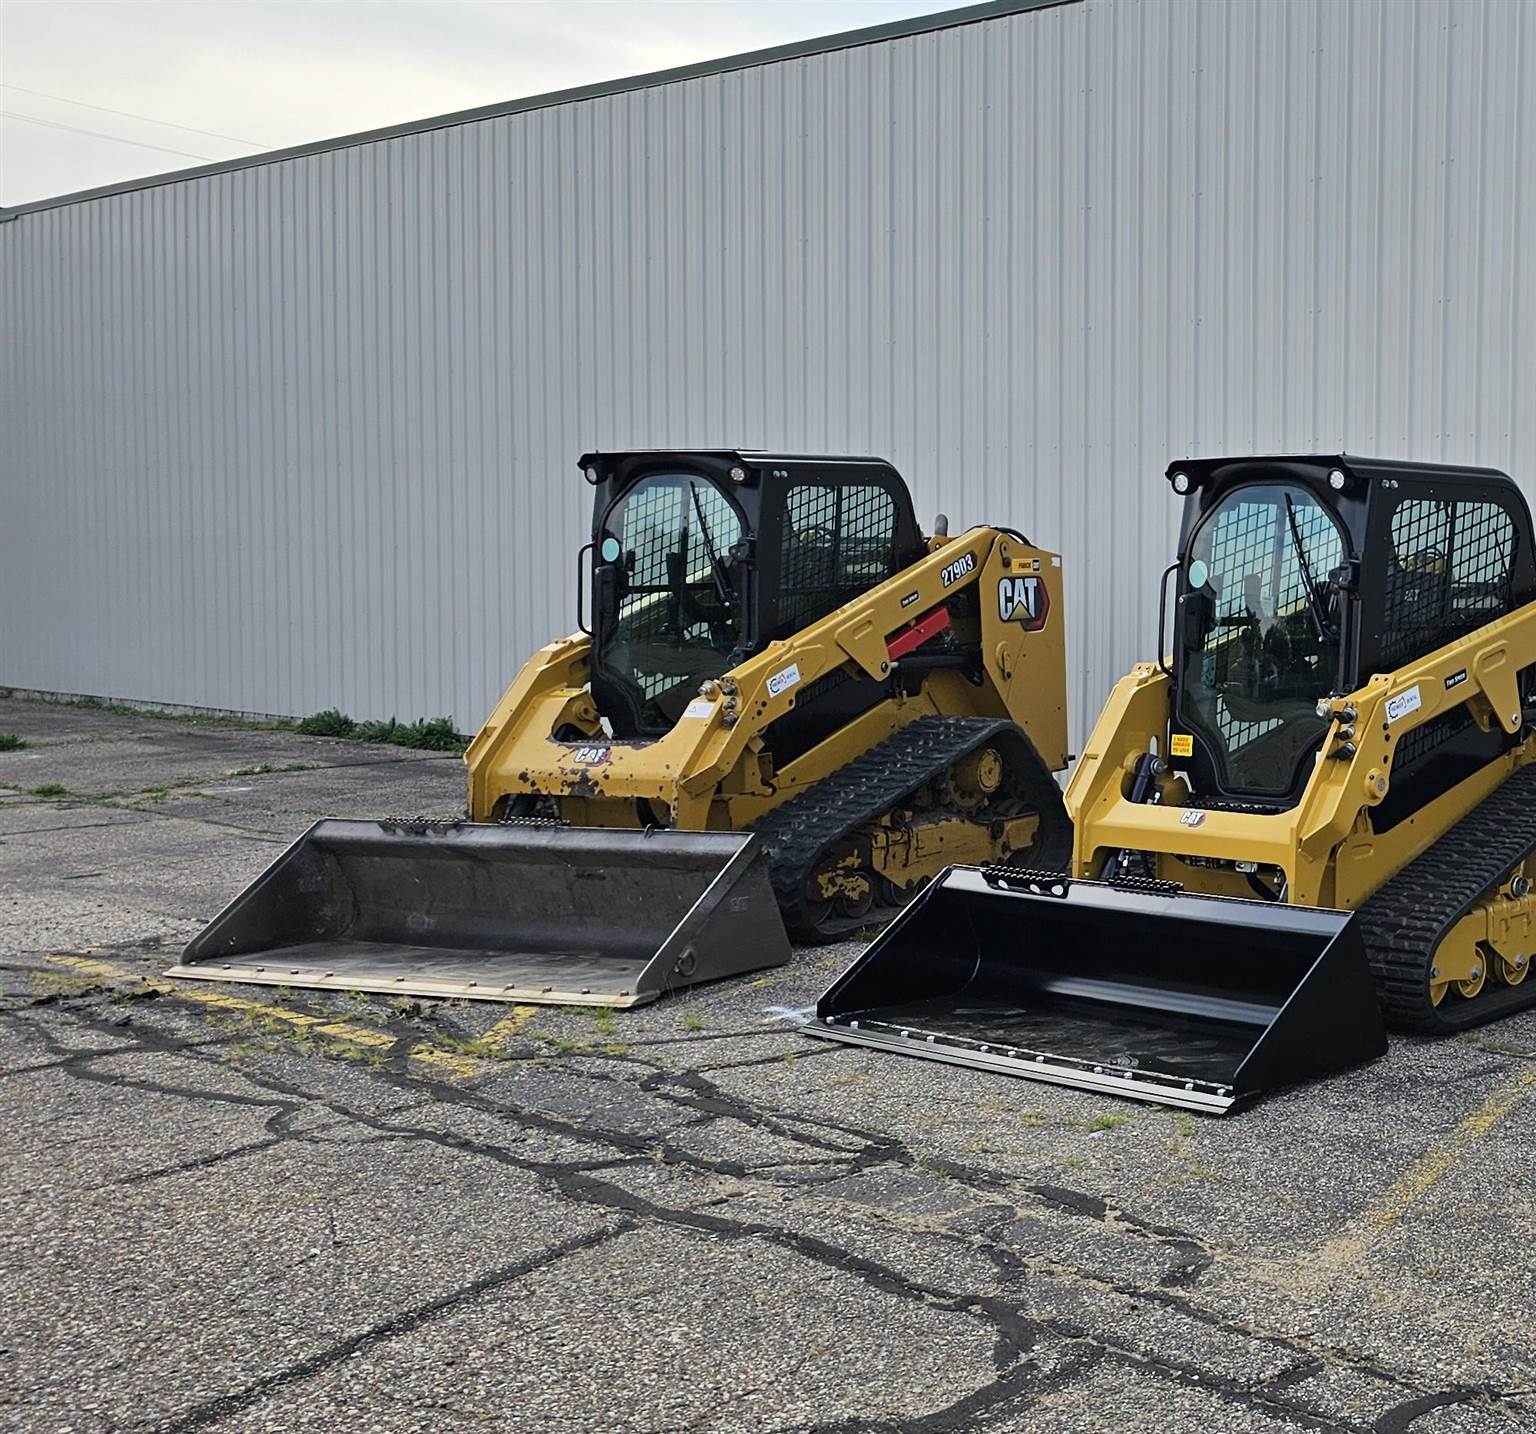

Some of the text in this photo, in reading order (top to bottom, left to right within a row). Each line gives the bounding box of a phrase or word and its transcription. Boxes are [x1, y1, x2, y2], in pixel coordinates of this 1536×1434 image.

[941, 553, 974, 588] 279D3
[998, 577, 1038, 622] CAT
[1180, 811, 1204, 825] CAT
